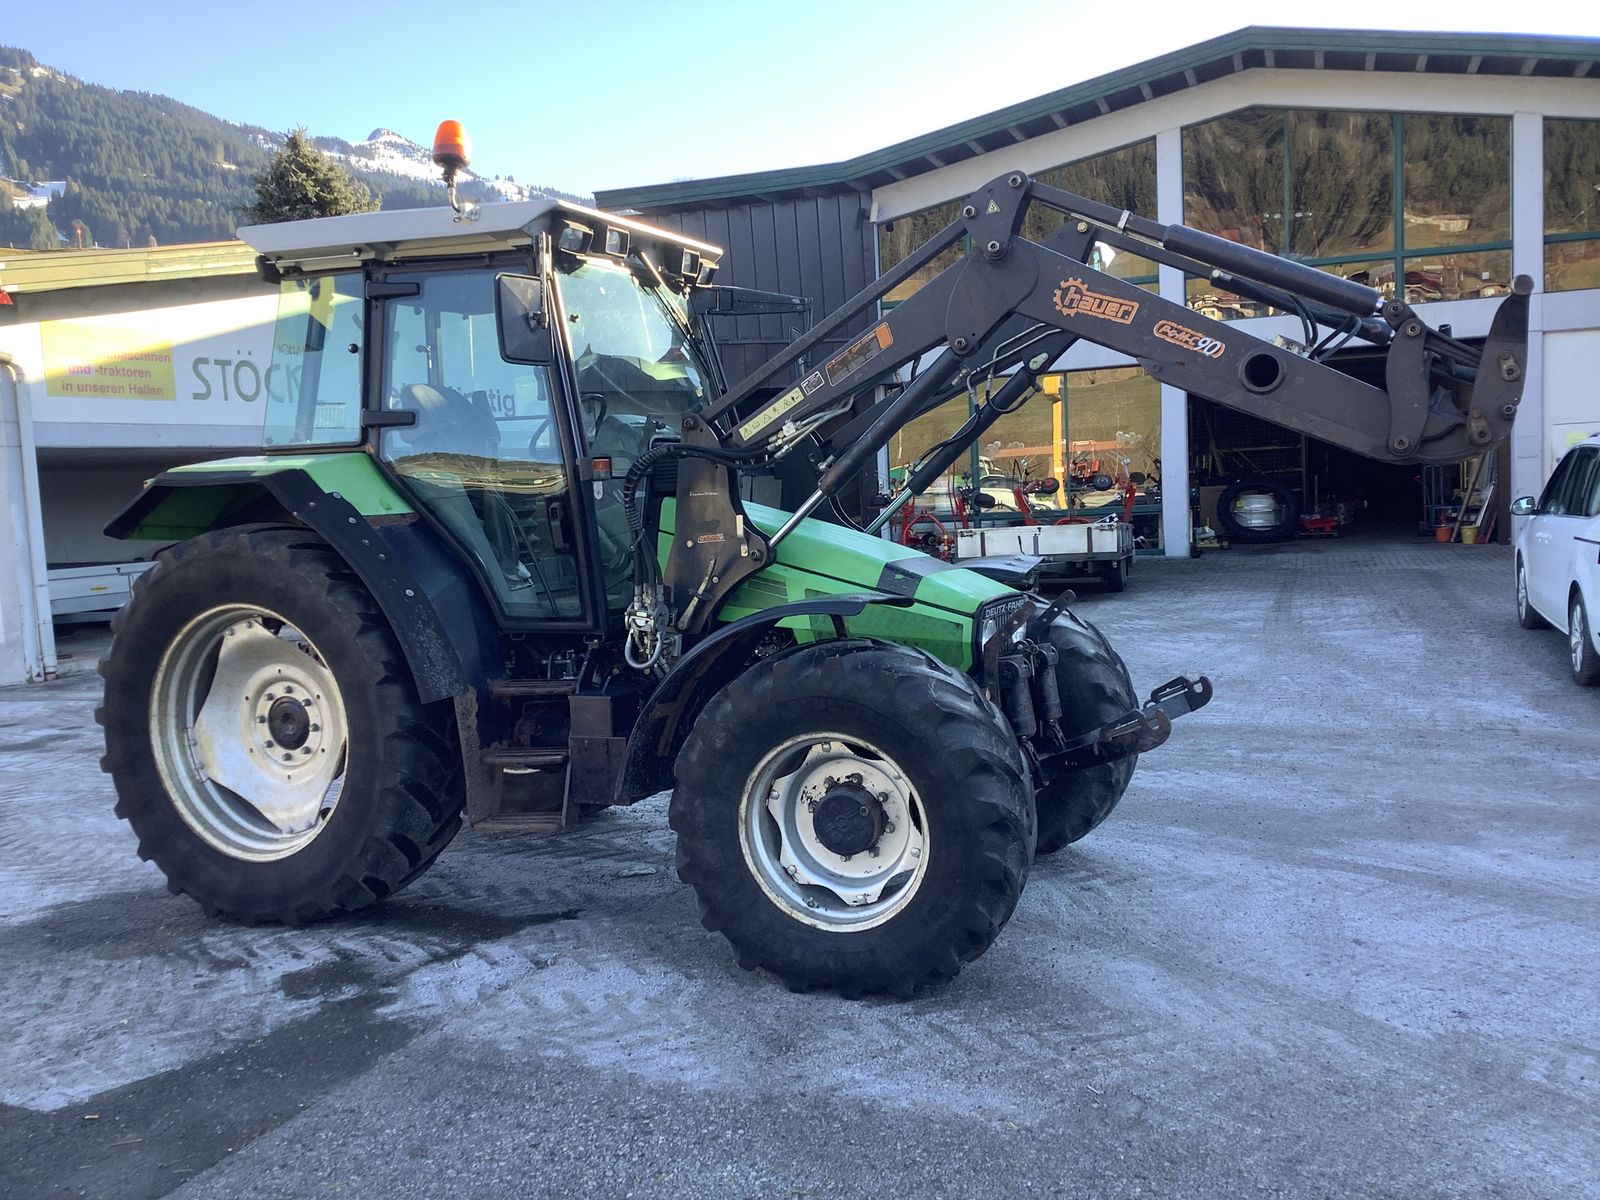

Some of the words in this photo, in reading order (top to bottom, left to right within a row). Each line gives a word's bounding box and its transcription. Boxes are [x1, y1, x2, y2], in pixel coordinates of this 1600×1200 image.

[1194, 337, 1222, 356] 90
[68, 364, 92, 375] und
[95, 364, 152, 379] -traktoren
[192, 350, 304, 404] STÖCK
[61, 380, 73, 392] in
[76, 384, 125, 395] unseren
[128, 383, 164, 396] Hallen
